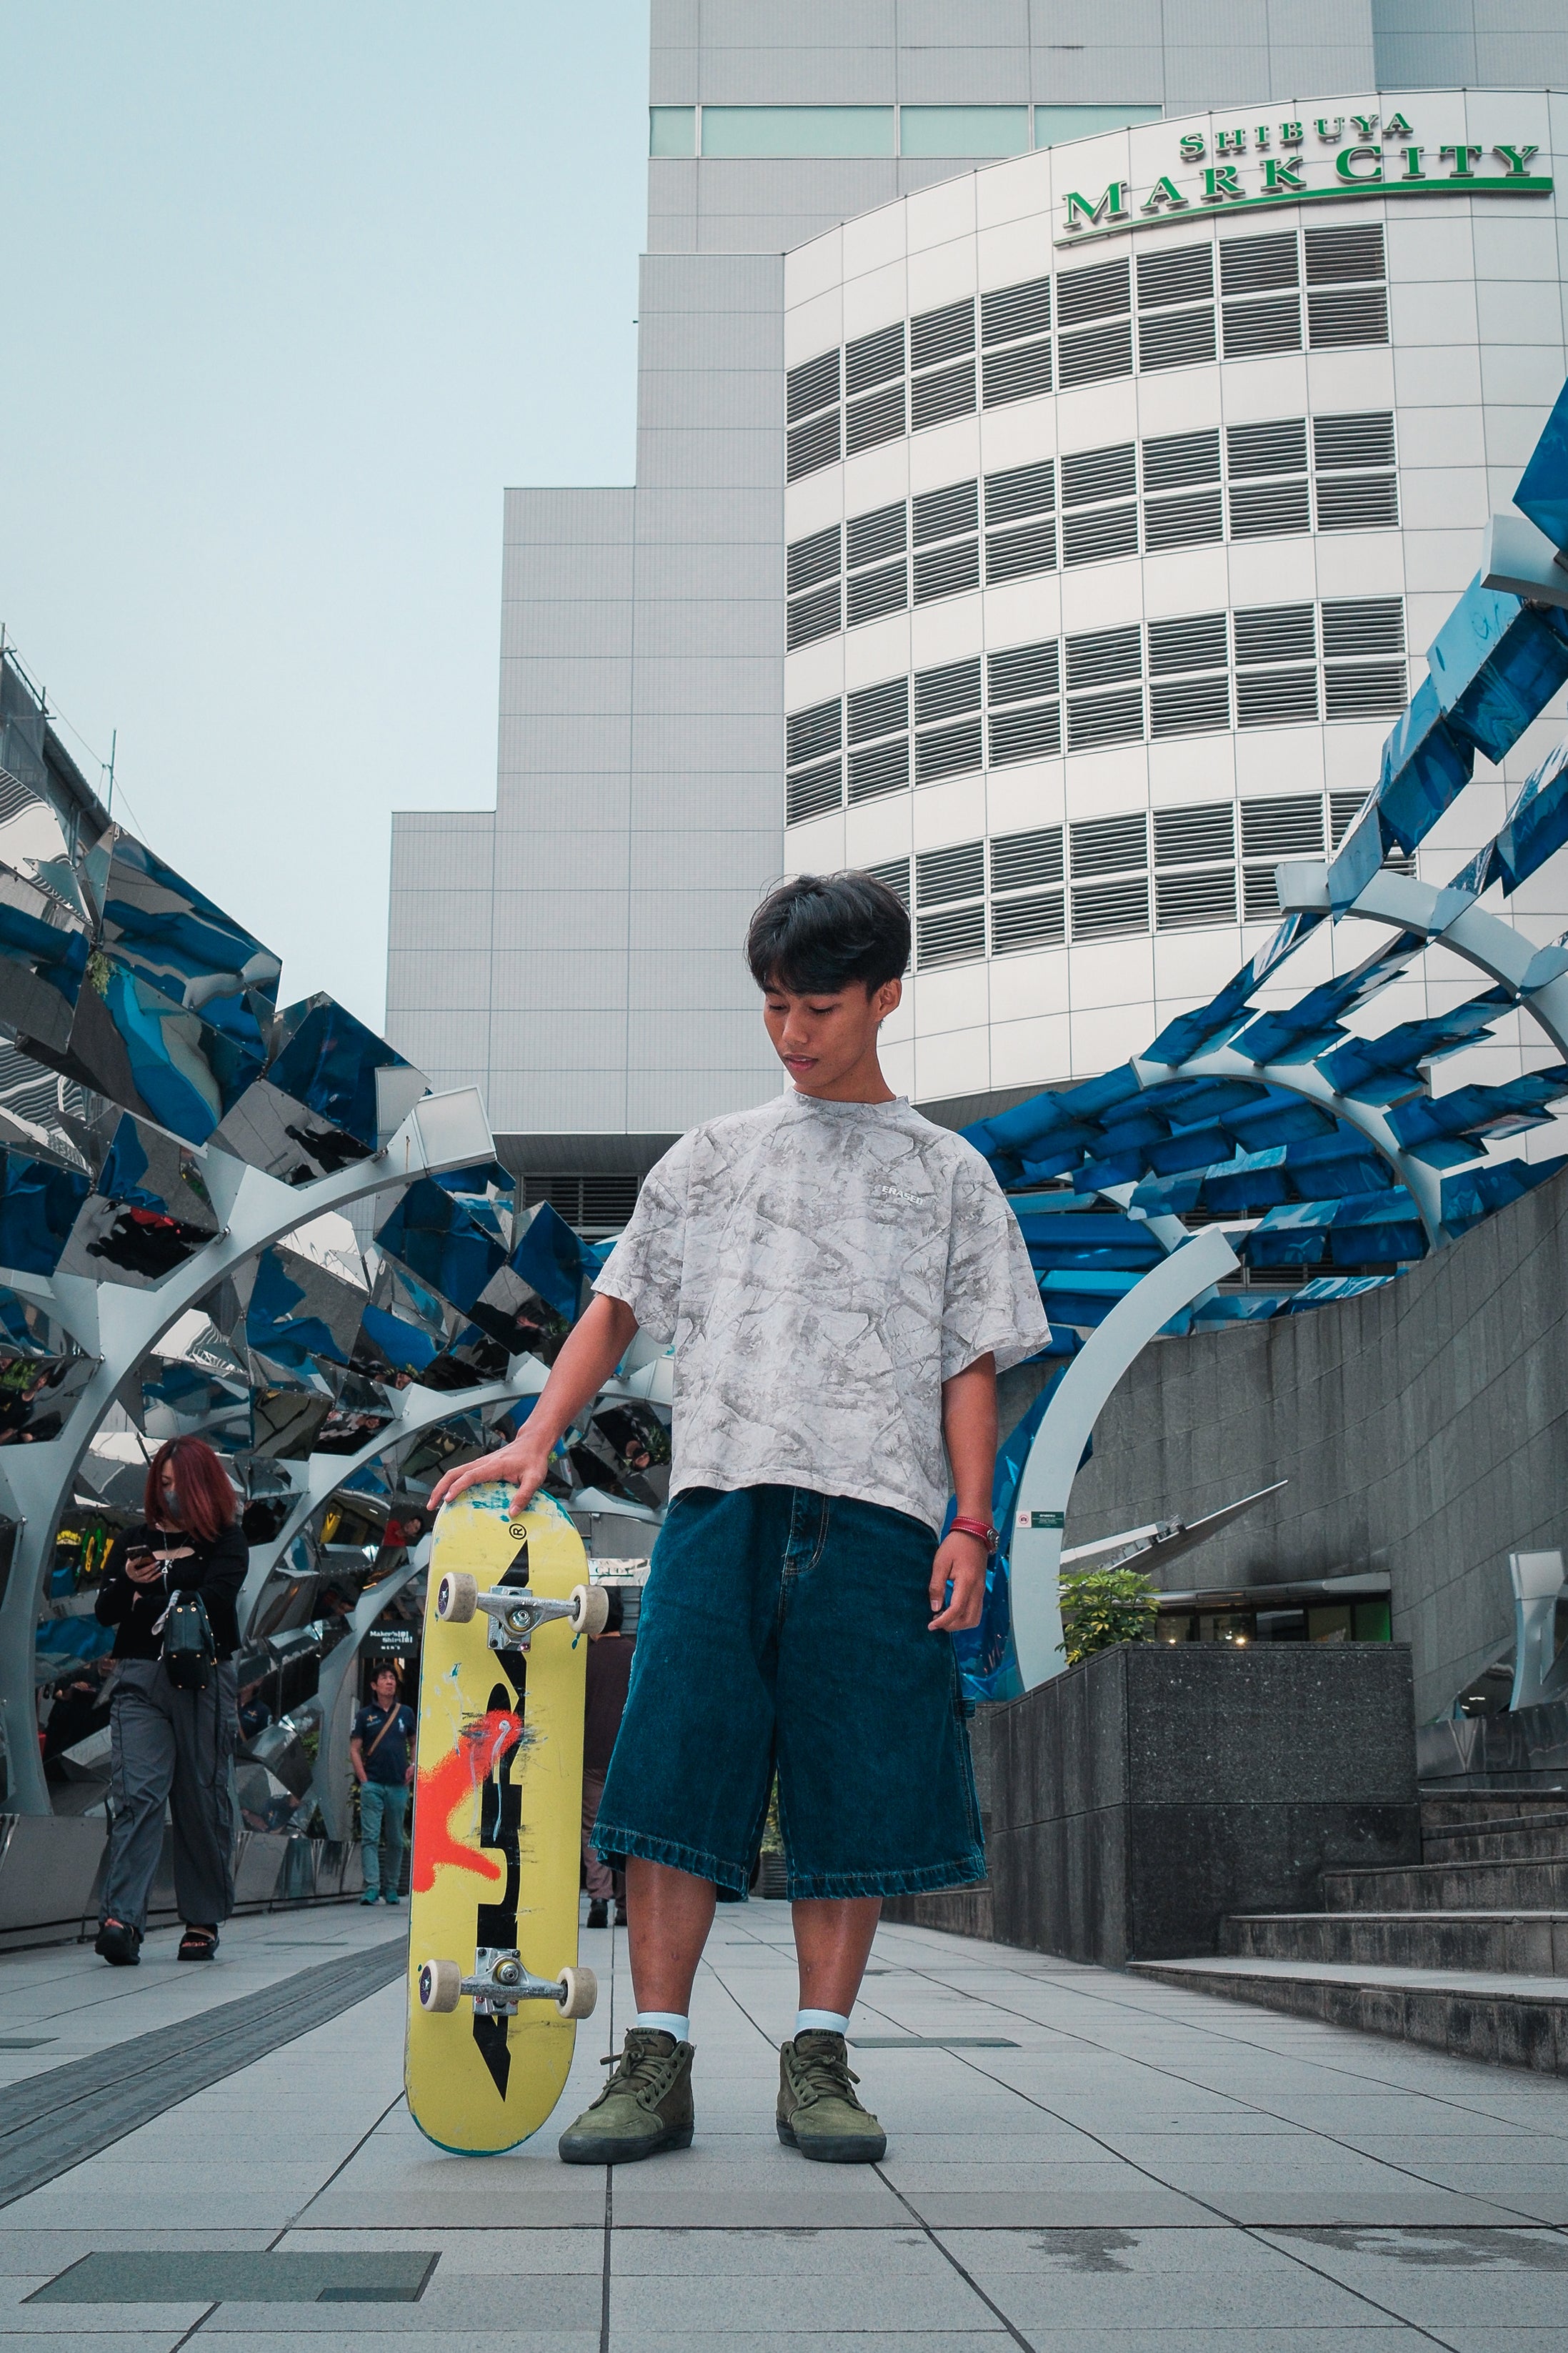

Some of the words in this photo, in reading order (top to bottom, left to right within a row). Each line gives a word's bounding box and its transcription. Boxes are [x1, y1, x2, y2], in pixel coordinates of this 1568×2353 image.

[1179, 112, 1414, 160] SHIBUYA
[1062, 155, 1307, 228] MARK
[1336, 145, 1539, 182] CITY
[882, 1185, 924, 1205] ERASED
